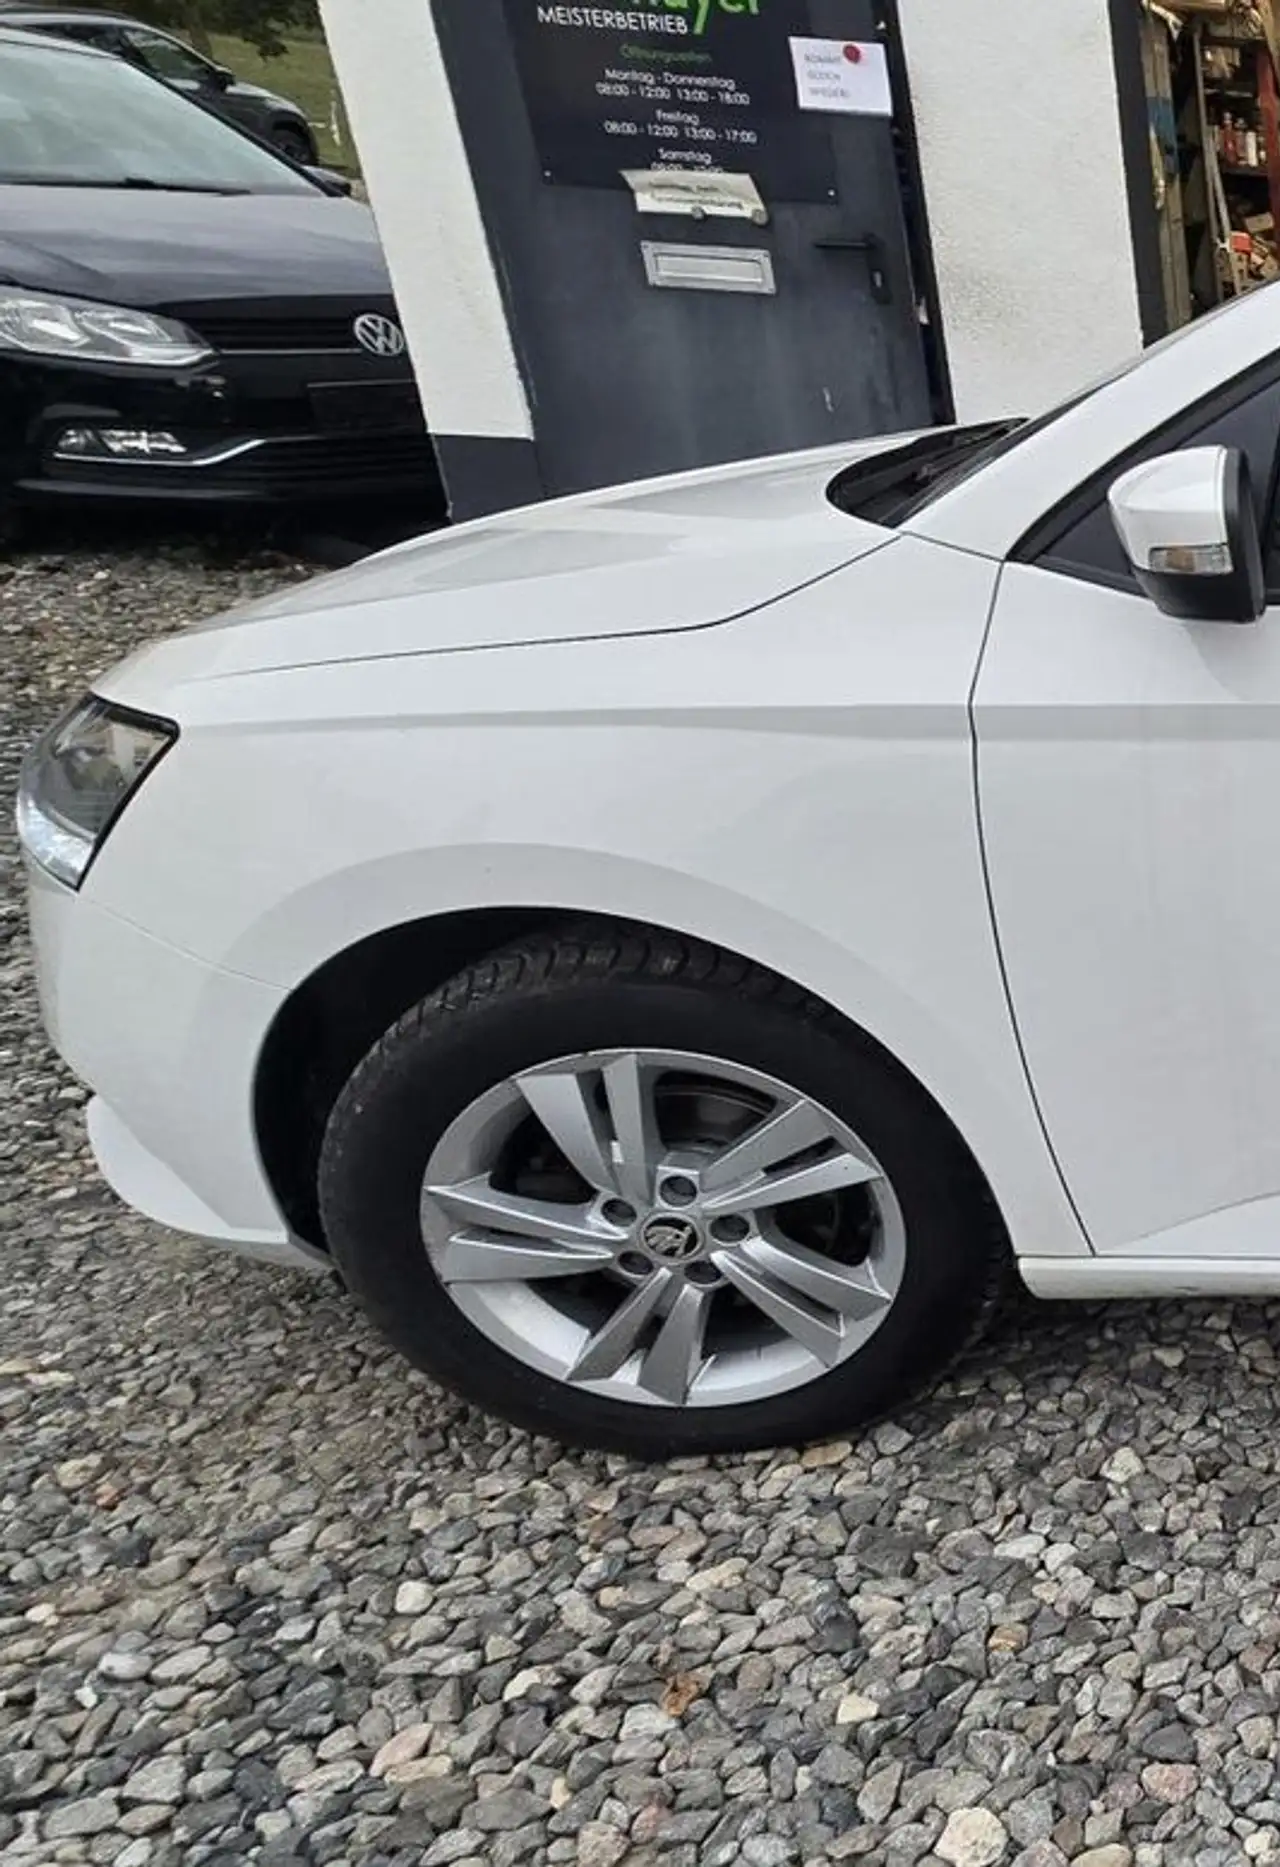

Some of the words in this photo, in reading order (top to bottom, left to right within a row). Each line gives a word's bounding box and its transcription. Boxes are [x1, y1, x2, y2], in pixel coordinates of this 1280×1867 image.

[537, 6, 688, 35] MEISTERBETRIEB
[605, 68, 655, 86] Montag
[639, 85, 671, 100] 12:00
[647, 123, 679, 139] 12:00
